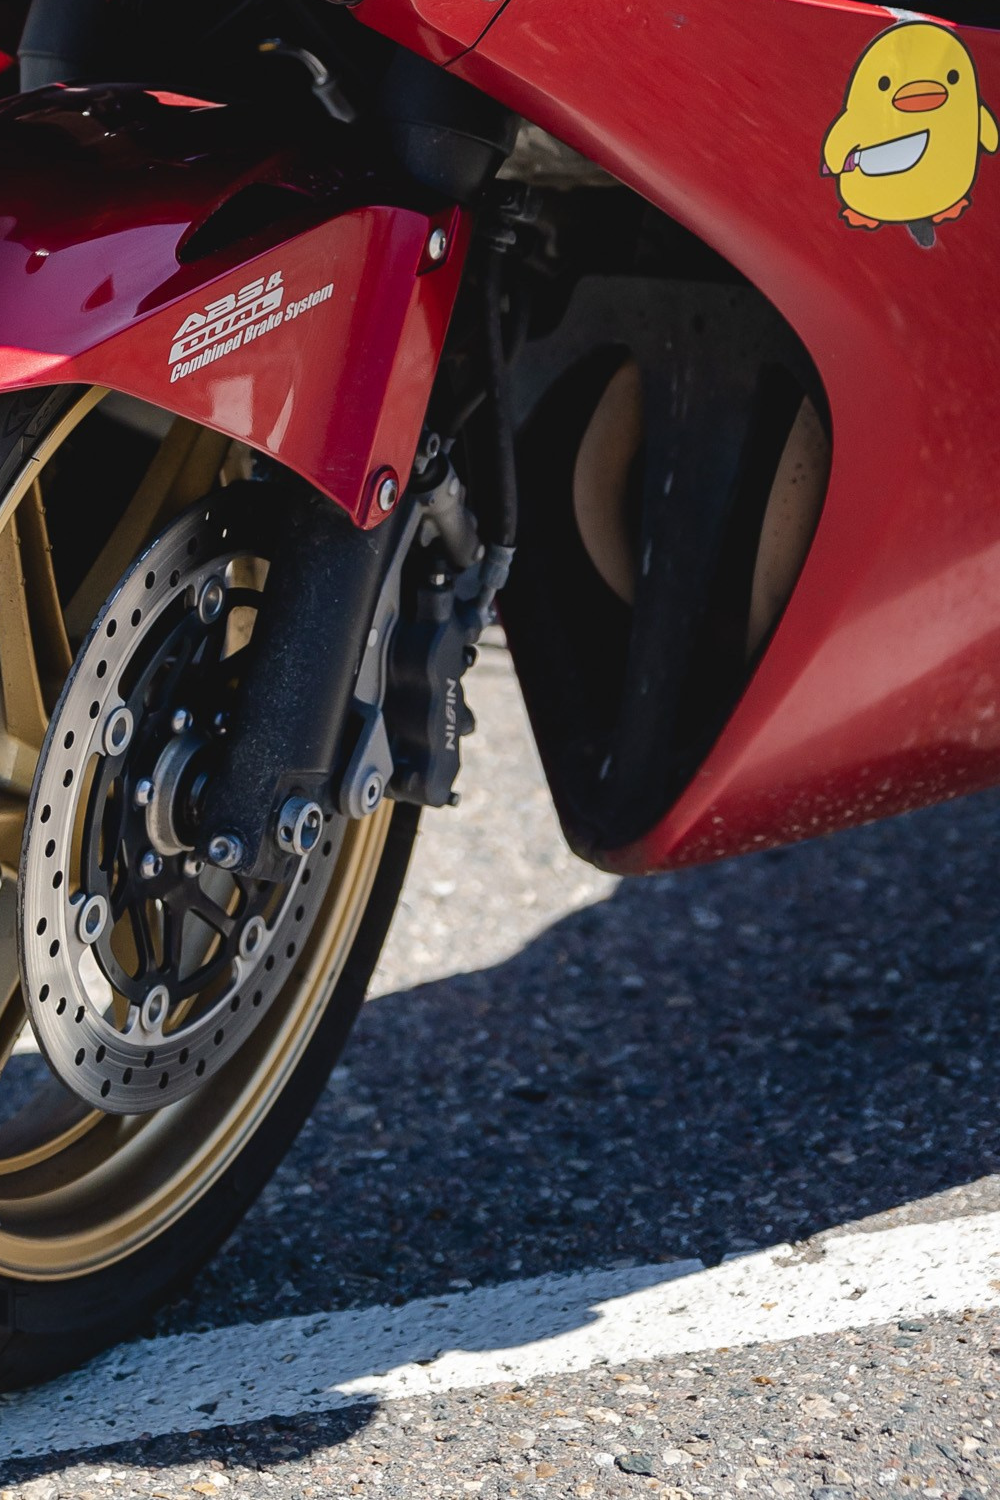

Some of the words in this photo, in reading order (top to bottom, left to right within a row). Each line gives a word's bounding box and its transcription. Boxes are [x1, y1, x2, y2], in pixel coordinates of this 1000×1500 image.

[170, 331, 243, 384] Combined
[243, 311, 284, 345] Brake
[284, 283, 334, 322] System
[172, 276, 265, 341] ABS
[180, 297, 281, 353] DUAL
